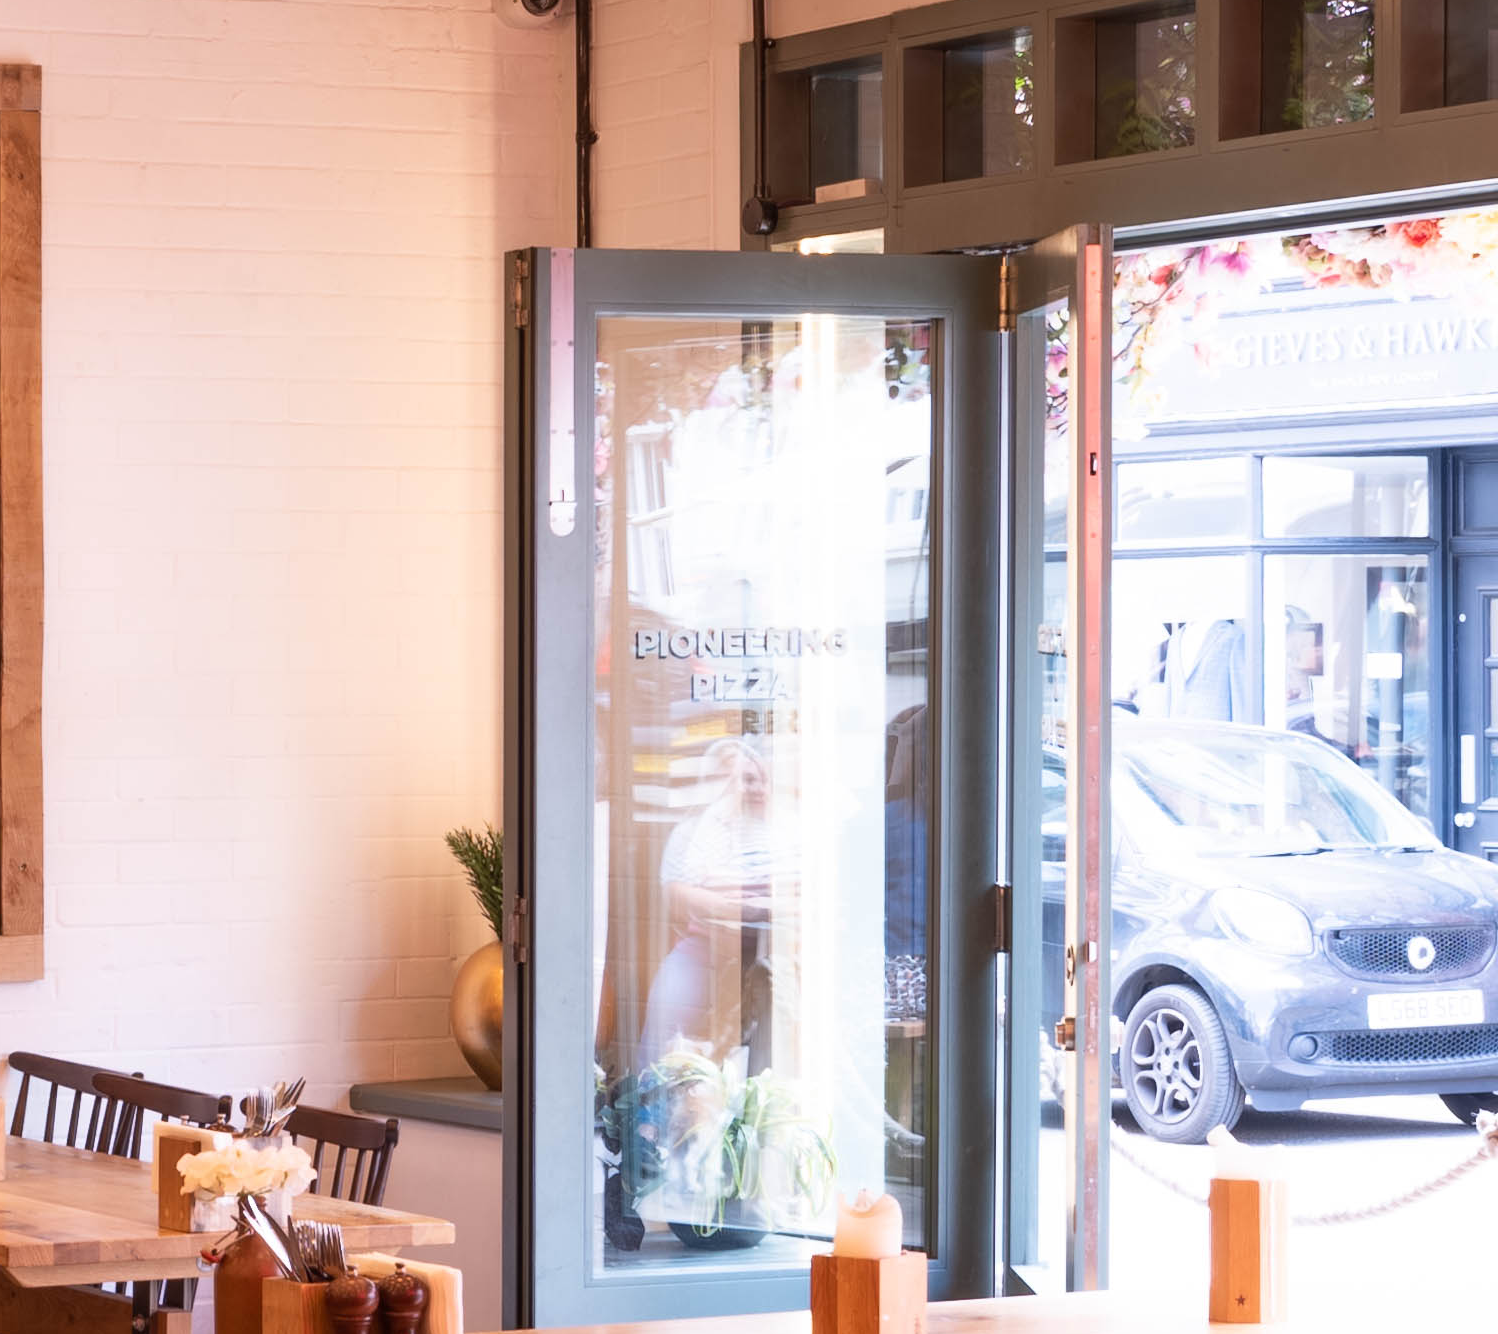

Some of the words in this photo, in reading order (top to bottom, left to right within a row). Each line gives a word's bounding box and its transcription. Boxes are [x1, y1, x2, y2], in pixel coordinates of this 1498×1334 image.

[1231, 327, 1346, 368] GIEVES
[635, 628, 847, 659] PIONEERING
[691, 670, 795, 701] PIZZA
